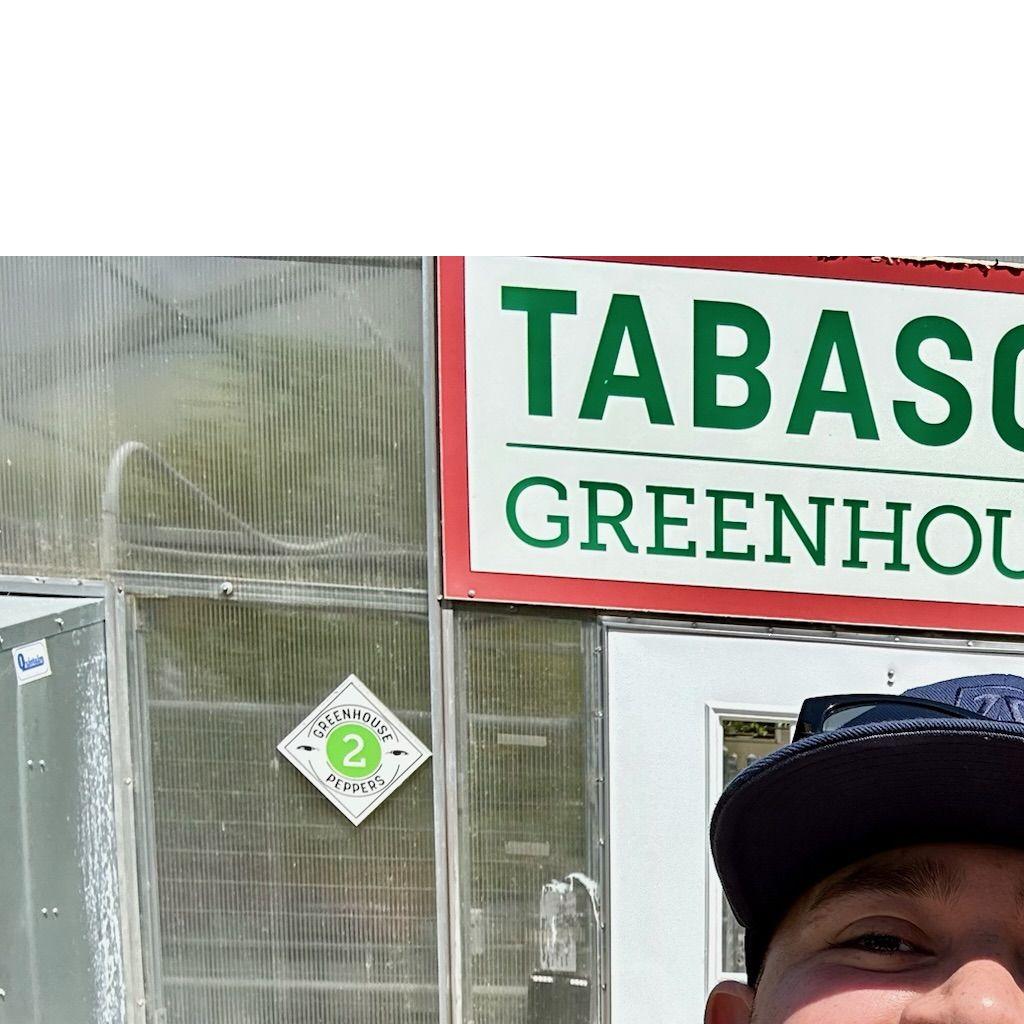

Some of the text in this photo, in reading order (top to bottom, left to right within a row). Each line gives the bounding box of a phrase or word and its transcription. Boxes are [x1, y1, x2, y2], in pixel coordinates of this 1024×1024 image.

[313, 708, 393, 743] GREENHOUSE
[342, 733, 366, 768] 2
[326, 773, 385, 794] PEPPERS
